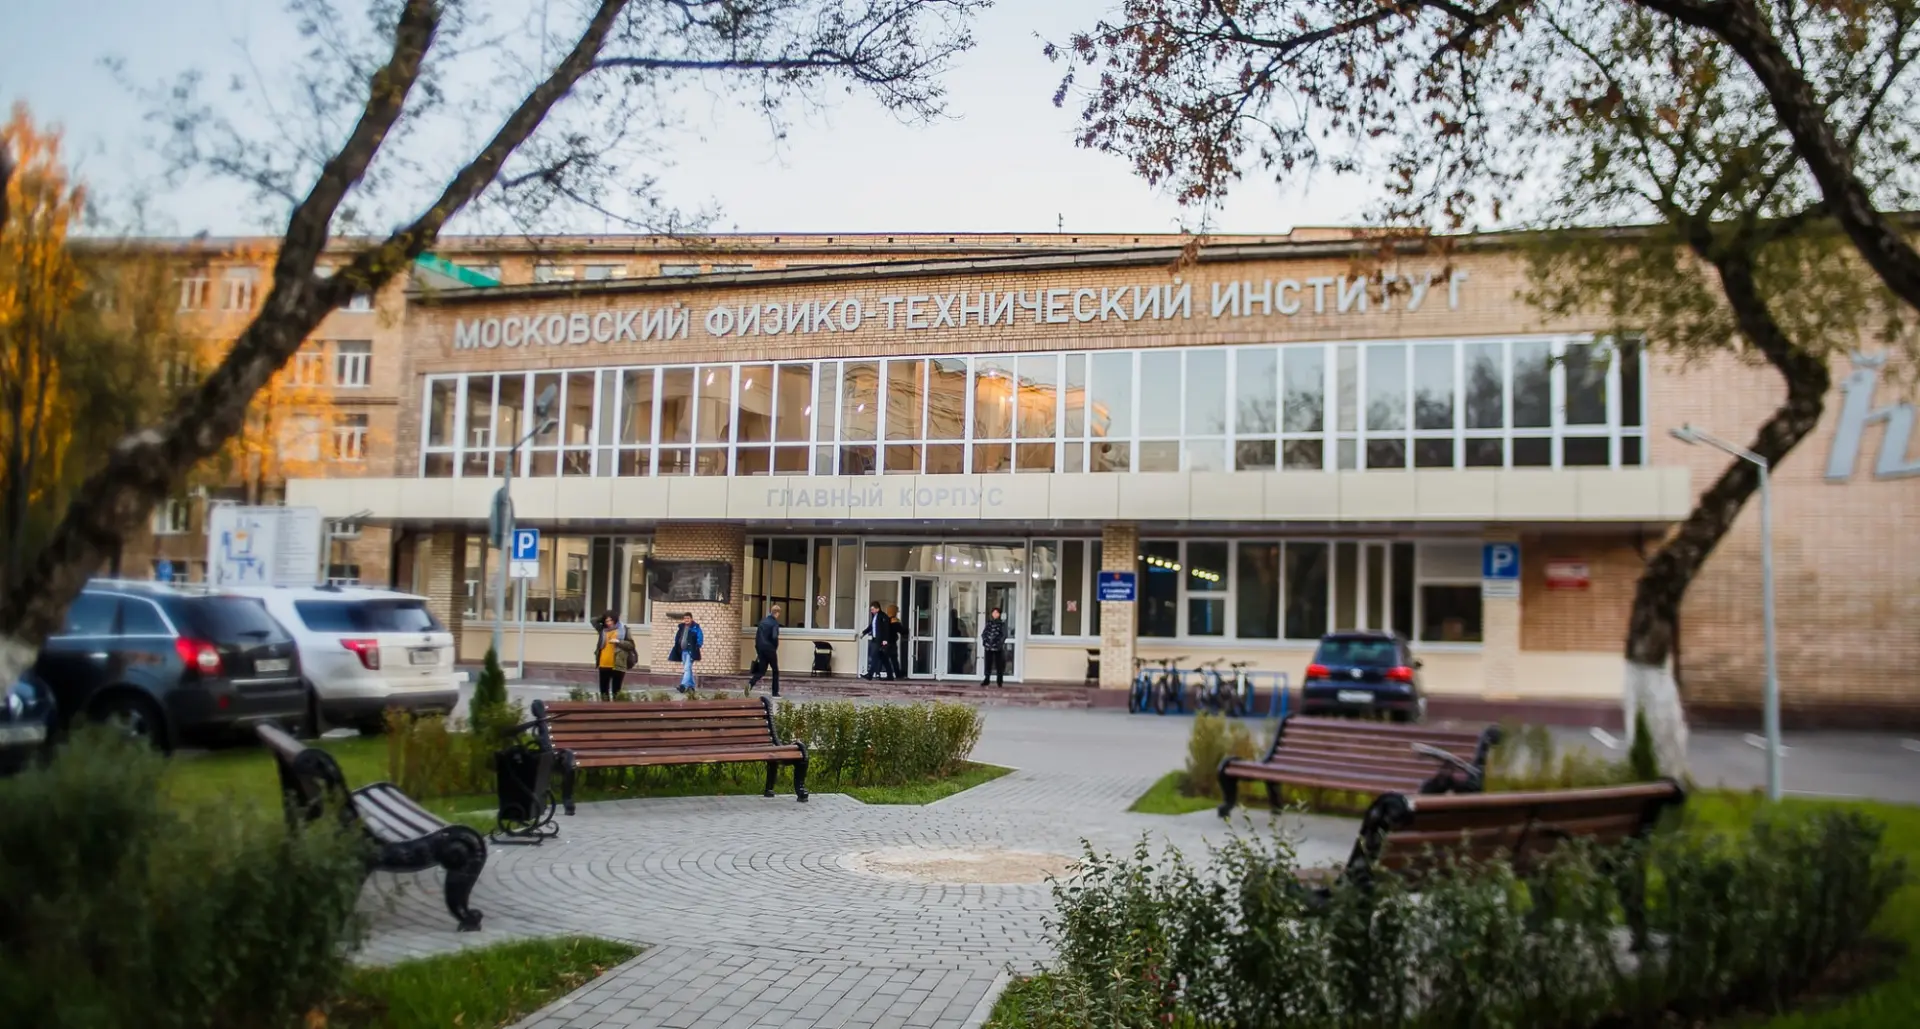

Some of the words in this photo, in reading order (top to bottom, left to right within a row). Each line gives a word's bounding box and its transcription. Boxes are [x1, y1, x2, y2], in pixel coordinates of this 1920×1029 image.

[454, 303, 692, 350] МОСКОВСКИЙ
[704, 277, 1192, 337] ФИЗИКО-ТЕХНИЧЕСКИЙ
[766, 482, 883, 508] ГЛАВНЫЙ
[899, 486, 1004, 508] КОРПУС
[518, 532, 535, 558] P
[1491, 544, 1514, 578] P
